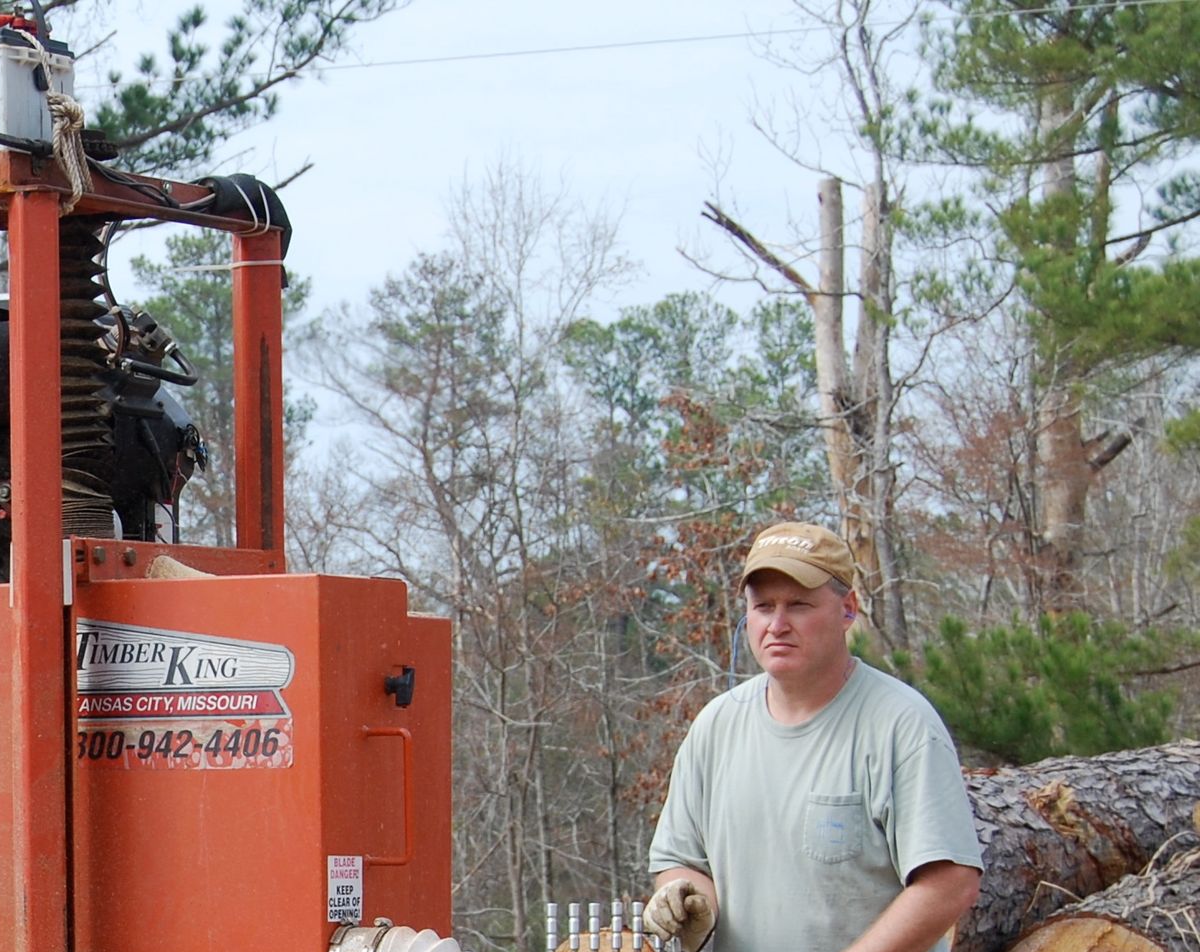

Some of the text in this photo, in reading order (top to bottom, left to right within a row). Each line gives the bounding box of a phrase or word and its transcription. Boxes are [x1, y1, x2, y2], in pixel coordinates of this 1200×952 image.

[77, 632, 238, 686] TIMBER KING
[77, 694, 258, 714] ANSAS CITY, MISSOURI
[334, 857, 355, 867] BLADE
[336, 885, 353, 895] KEEP
[329, 897, 360, 907] CLEAR OF
[329, 908, 360, 919] OPENING!
